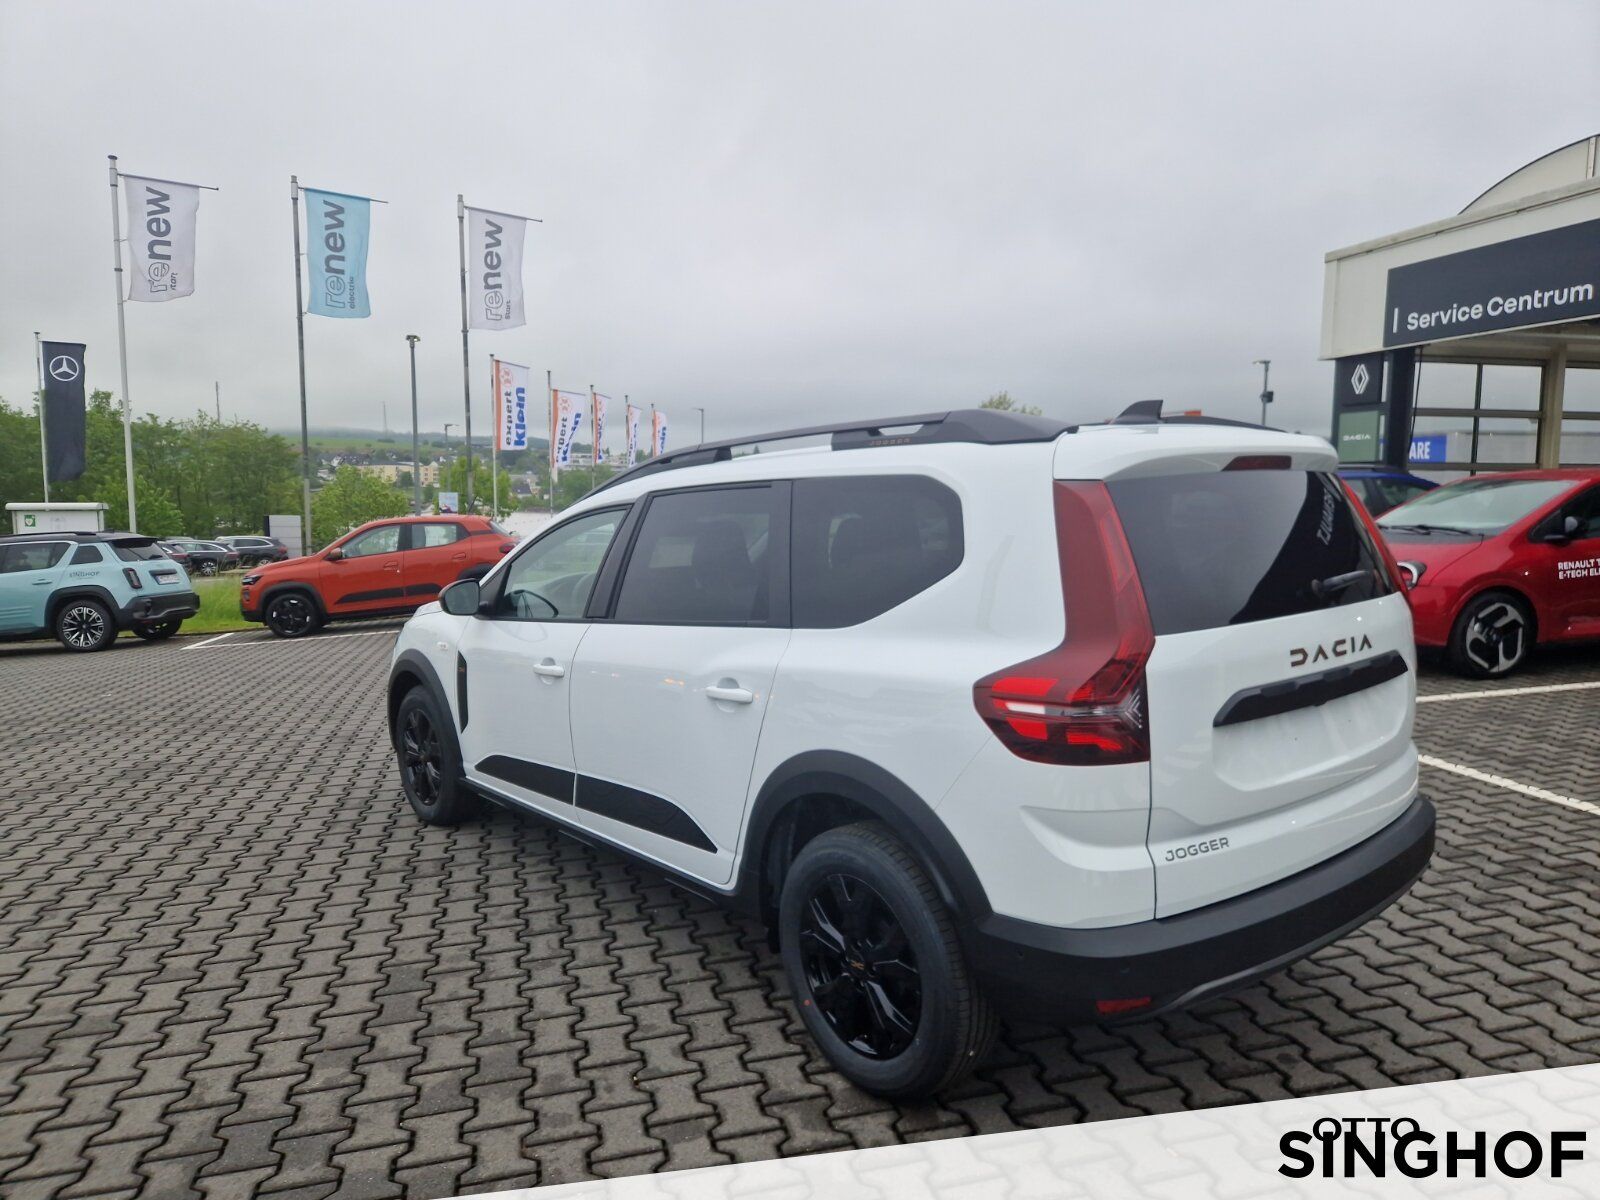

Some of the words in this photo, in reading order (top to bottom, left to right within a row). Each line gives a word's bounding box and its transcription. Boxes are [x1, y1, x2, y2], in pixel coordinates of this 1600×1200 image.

[145, 185, 172, 293] renew
[323, 199, 346, 309] renew
[483, 218, 504, 321] renew
[1406, 302, 1483, 331] Service
[1486, 283, 1594, 317] Centrum
[504, 391, 513, 446] expert
[514, 387, 526, 446] Klein
[1558, 559, 1595, 570] RENAULT
[1559, 569, 1588, 579] E-TECH
[1289, 633, 1372, 668] DACIA
[1164, 836, 1230, 862] JOGGER
